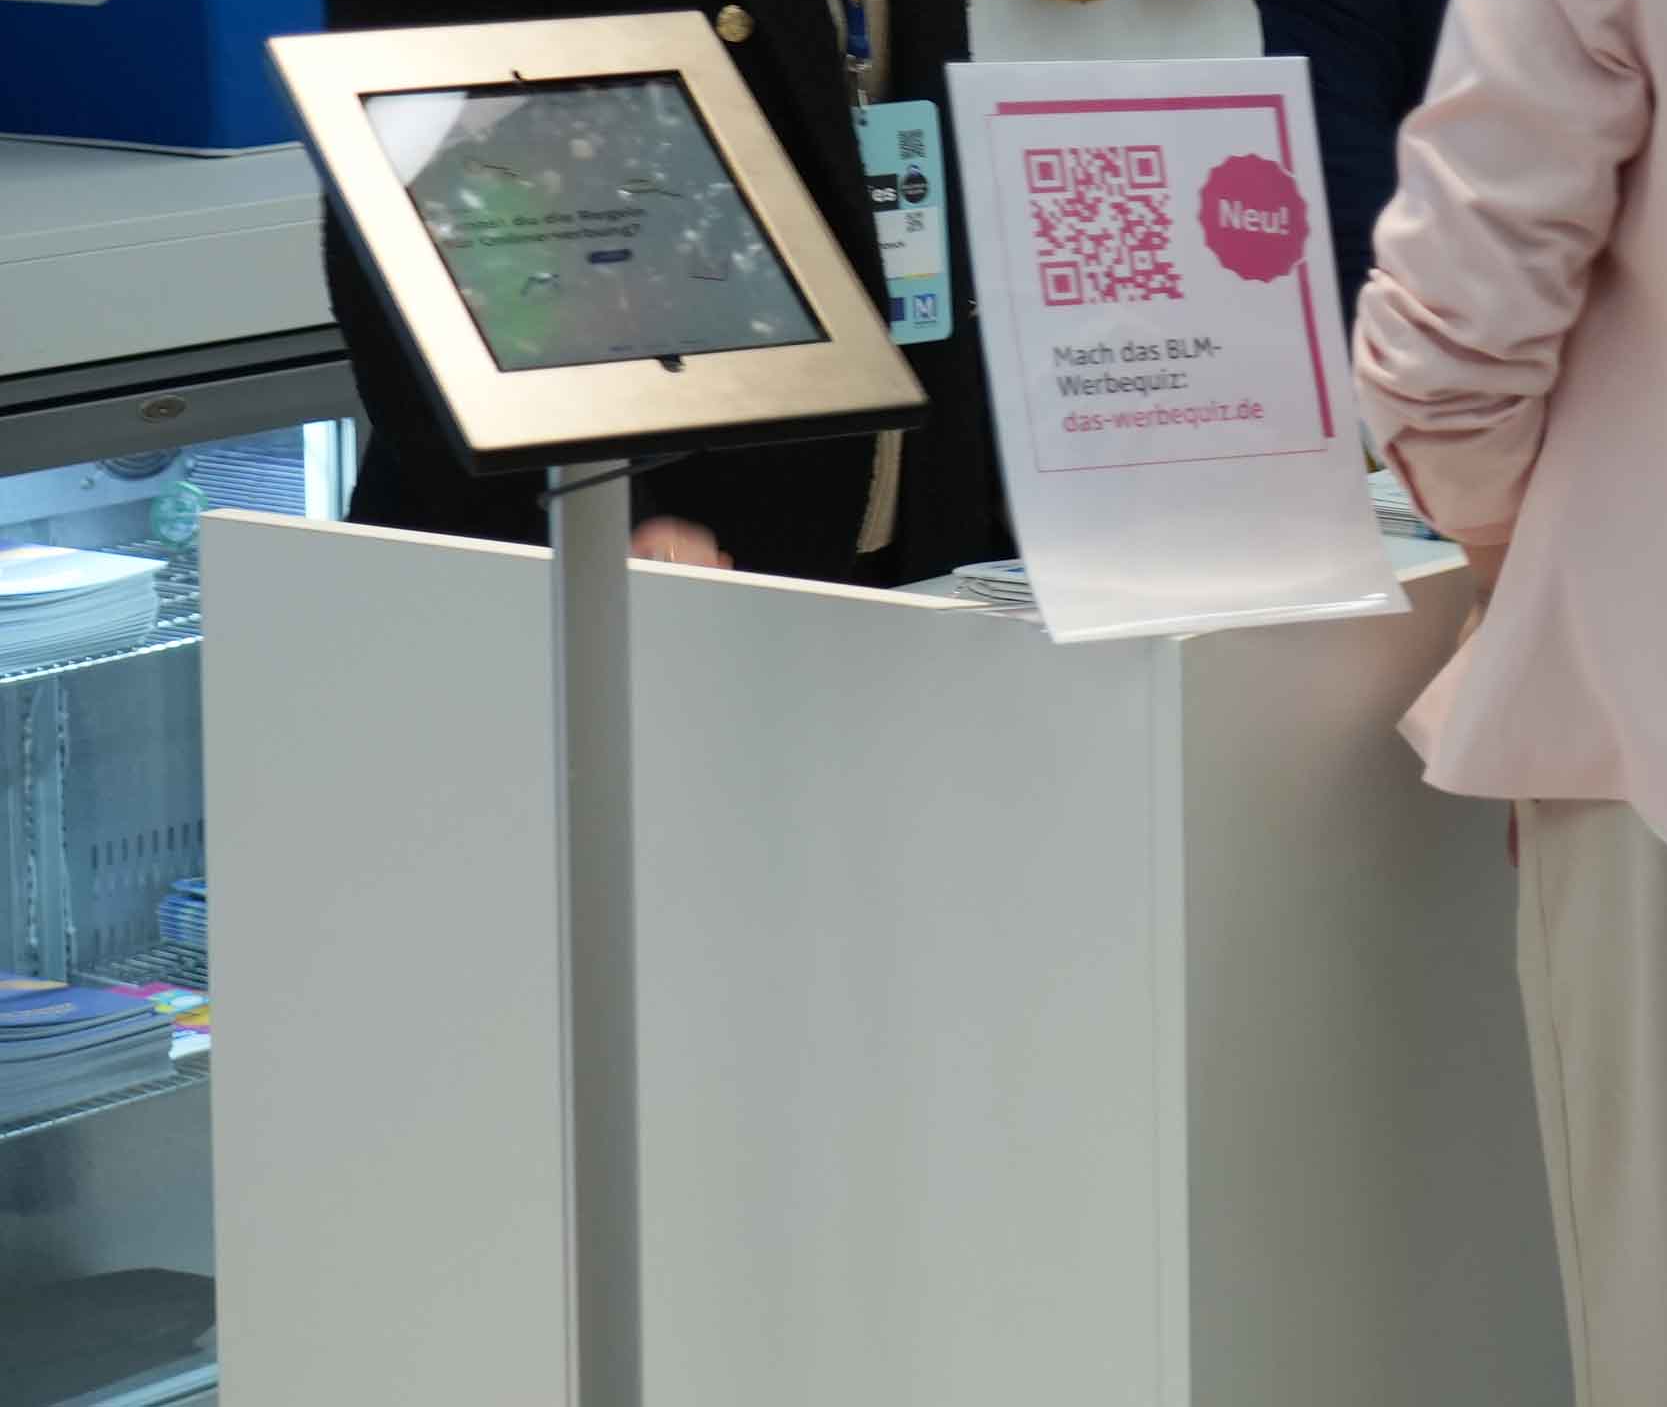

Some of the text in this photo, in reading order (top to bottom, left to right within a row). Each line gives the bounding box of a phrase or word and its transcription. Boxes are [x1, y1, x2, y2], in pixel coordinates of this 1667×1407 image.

[1217, 198, 1290, 236] Neu!
[1053, 337, 1222, 368] Mach das BLM-
[1057, 368, 1190, 399] Werbequiz:
[1063, 397, 1264, 434] das-werbequiz.de
